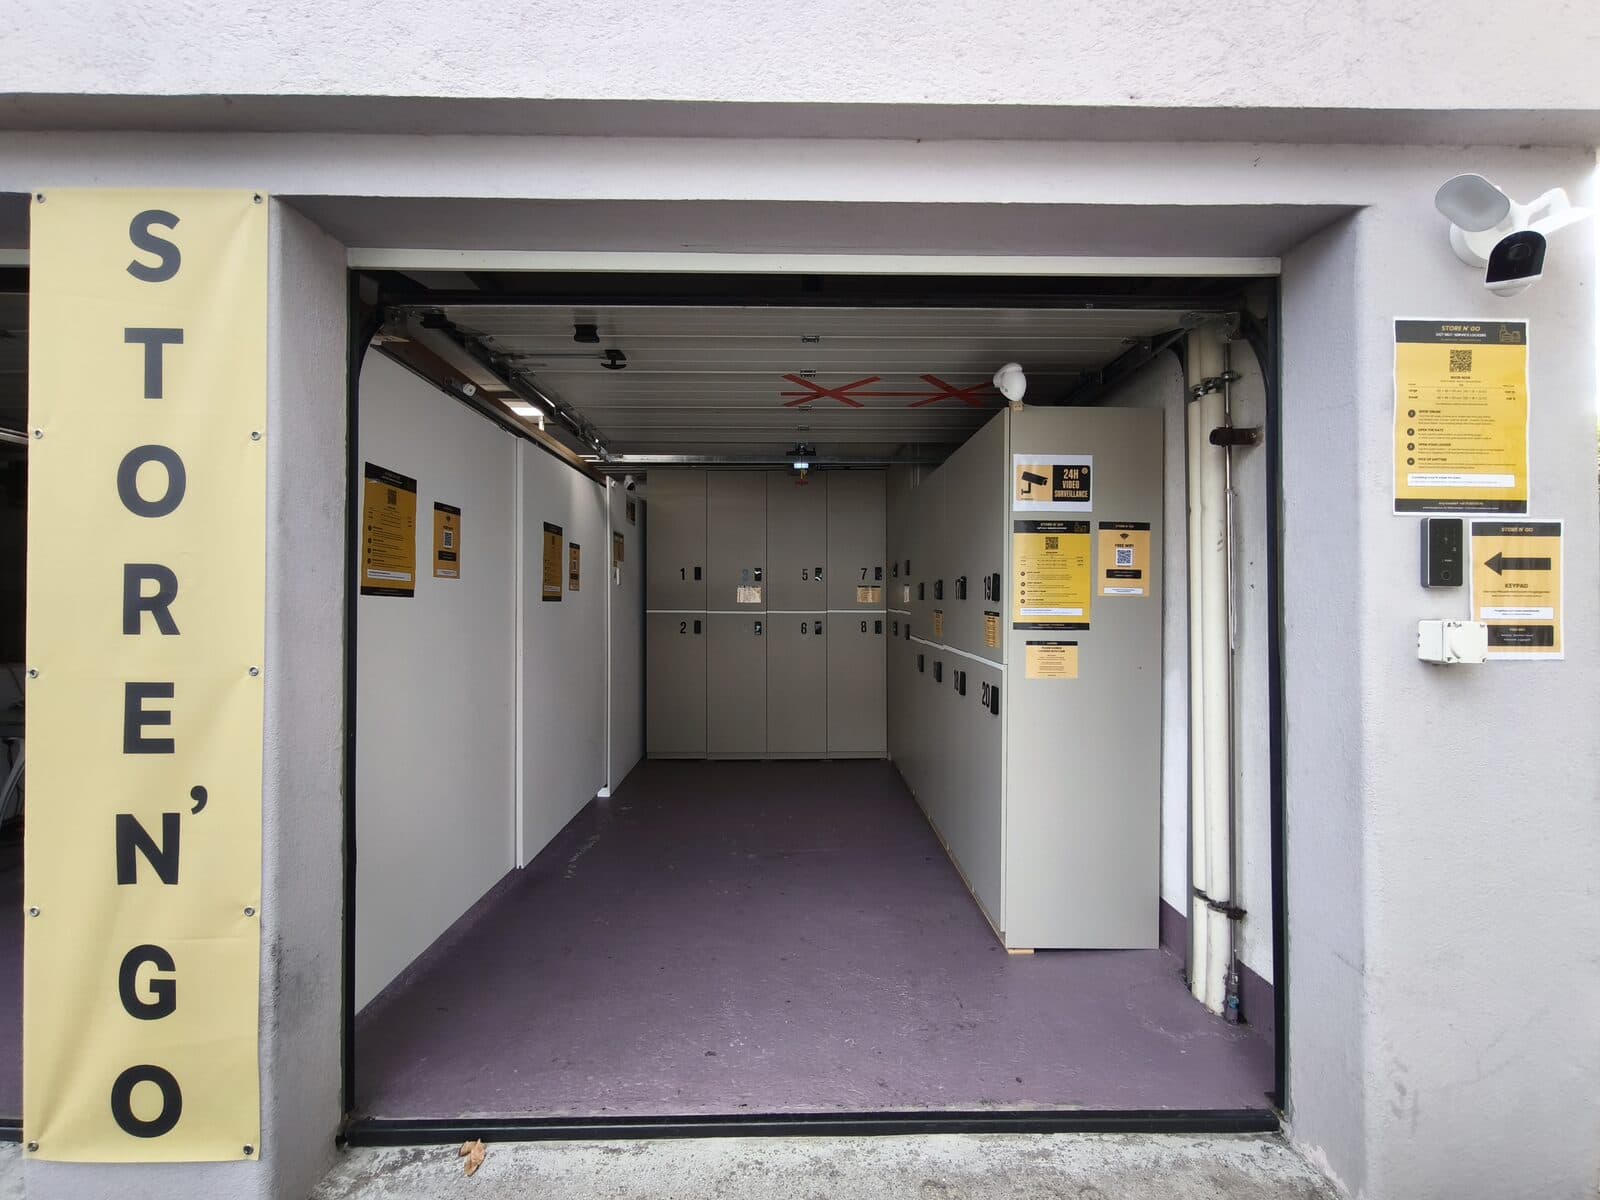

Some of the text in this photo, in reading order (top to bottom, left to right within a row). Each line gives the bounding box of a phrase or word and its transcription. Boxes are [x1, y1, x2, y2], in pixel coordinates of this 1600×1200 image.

[1063, 468, 1079, 479] 24H
[1062, 480, 1080, 489] VIDEO
[1054, 489, 1088, 498] SURVEILLANCE
[680, 567, 685, 580] 1
[801, 568, 808, 581] 5
[860, 567, 868, 580] 7
[983, 576, 992, 601] 19
[680, 621, 687, 634] 2
[801, 622, 807, 635] 6
[860, 620, 867, 633] 8
[981, 681, 991, 708] 20
